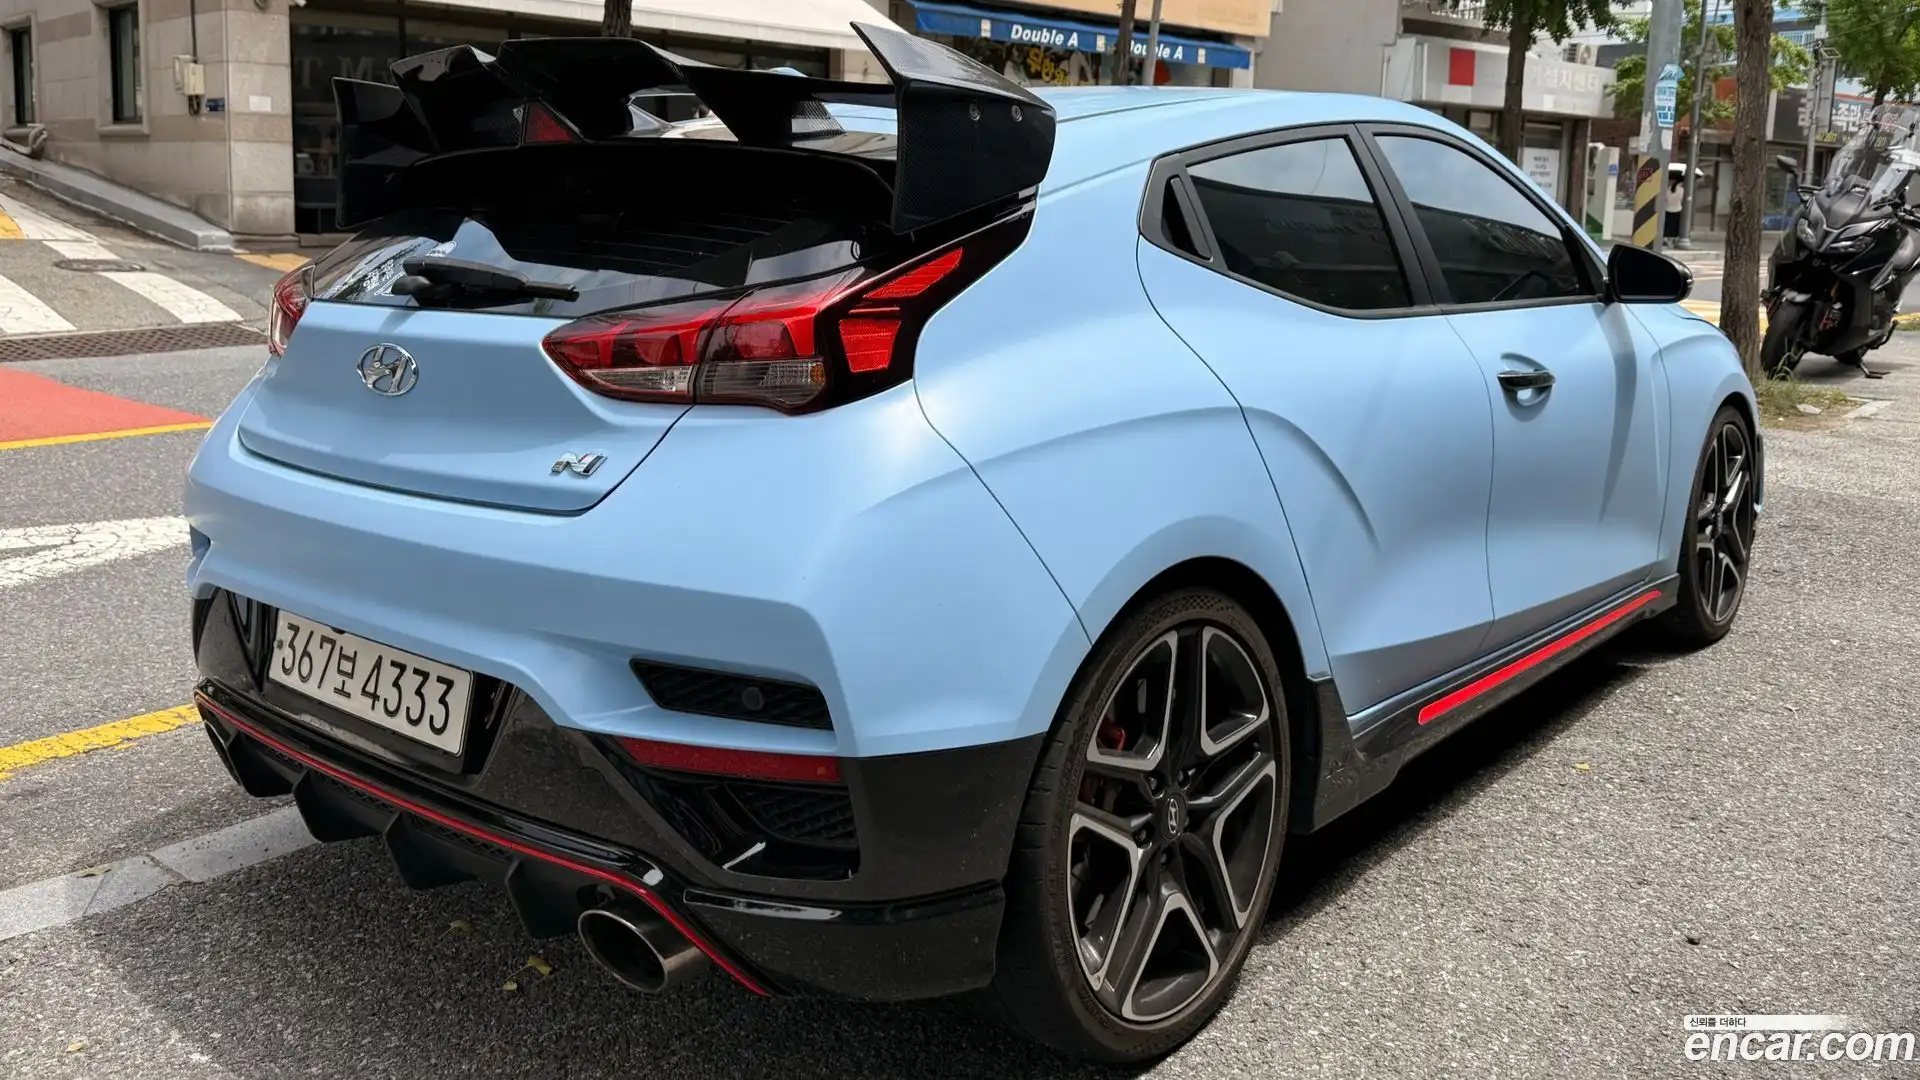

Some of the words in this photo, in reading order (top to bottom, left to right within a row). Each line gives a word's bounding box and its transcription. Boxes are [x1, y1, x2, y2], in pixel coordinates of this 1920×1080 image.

[1011, 24, 1064, 45] Double
[1067, 32, 1079, 47] A
[1130, 40, 1170, 59] oule
[1174, 46, 1183, 60] A
